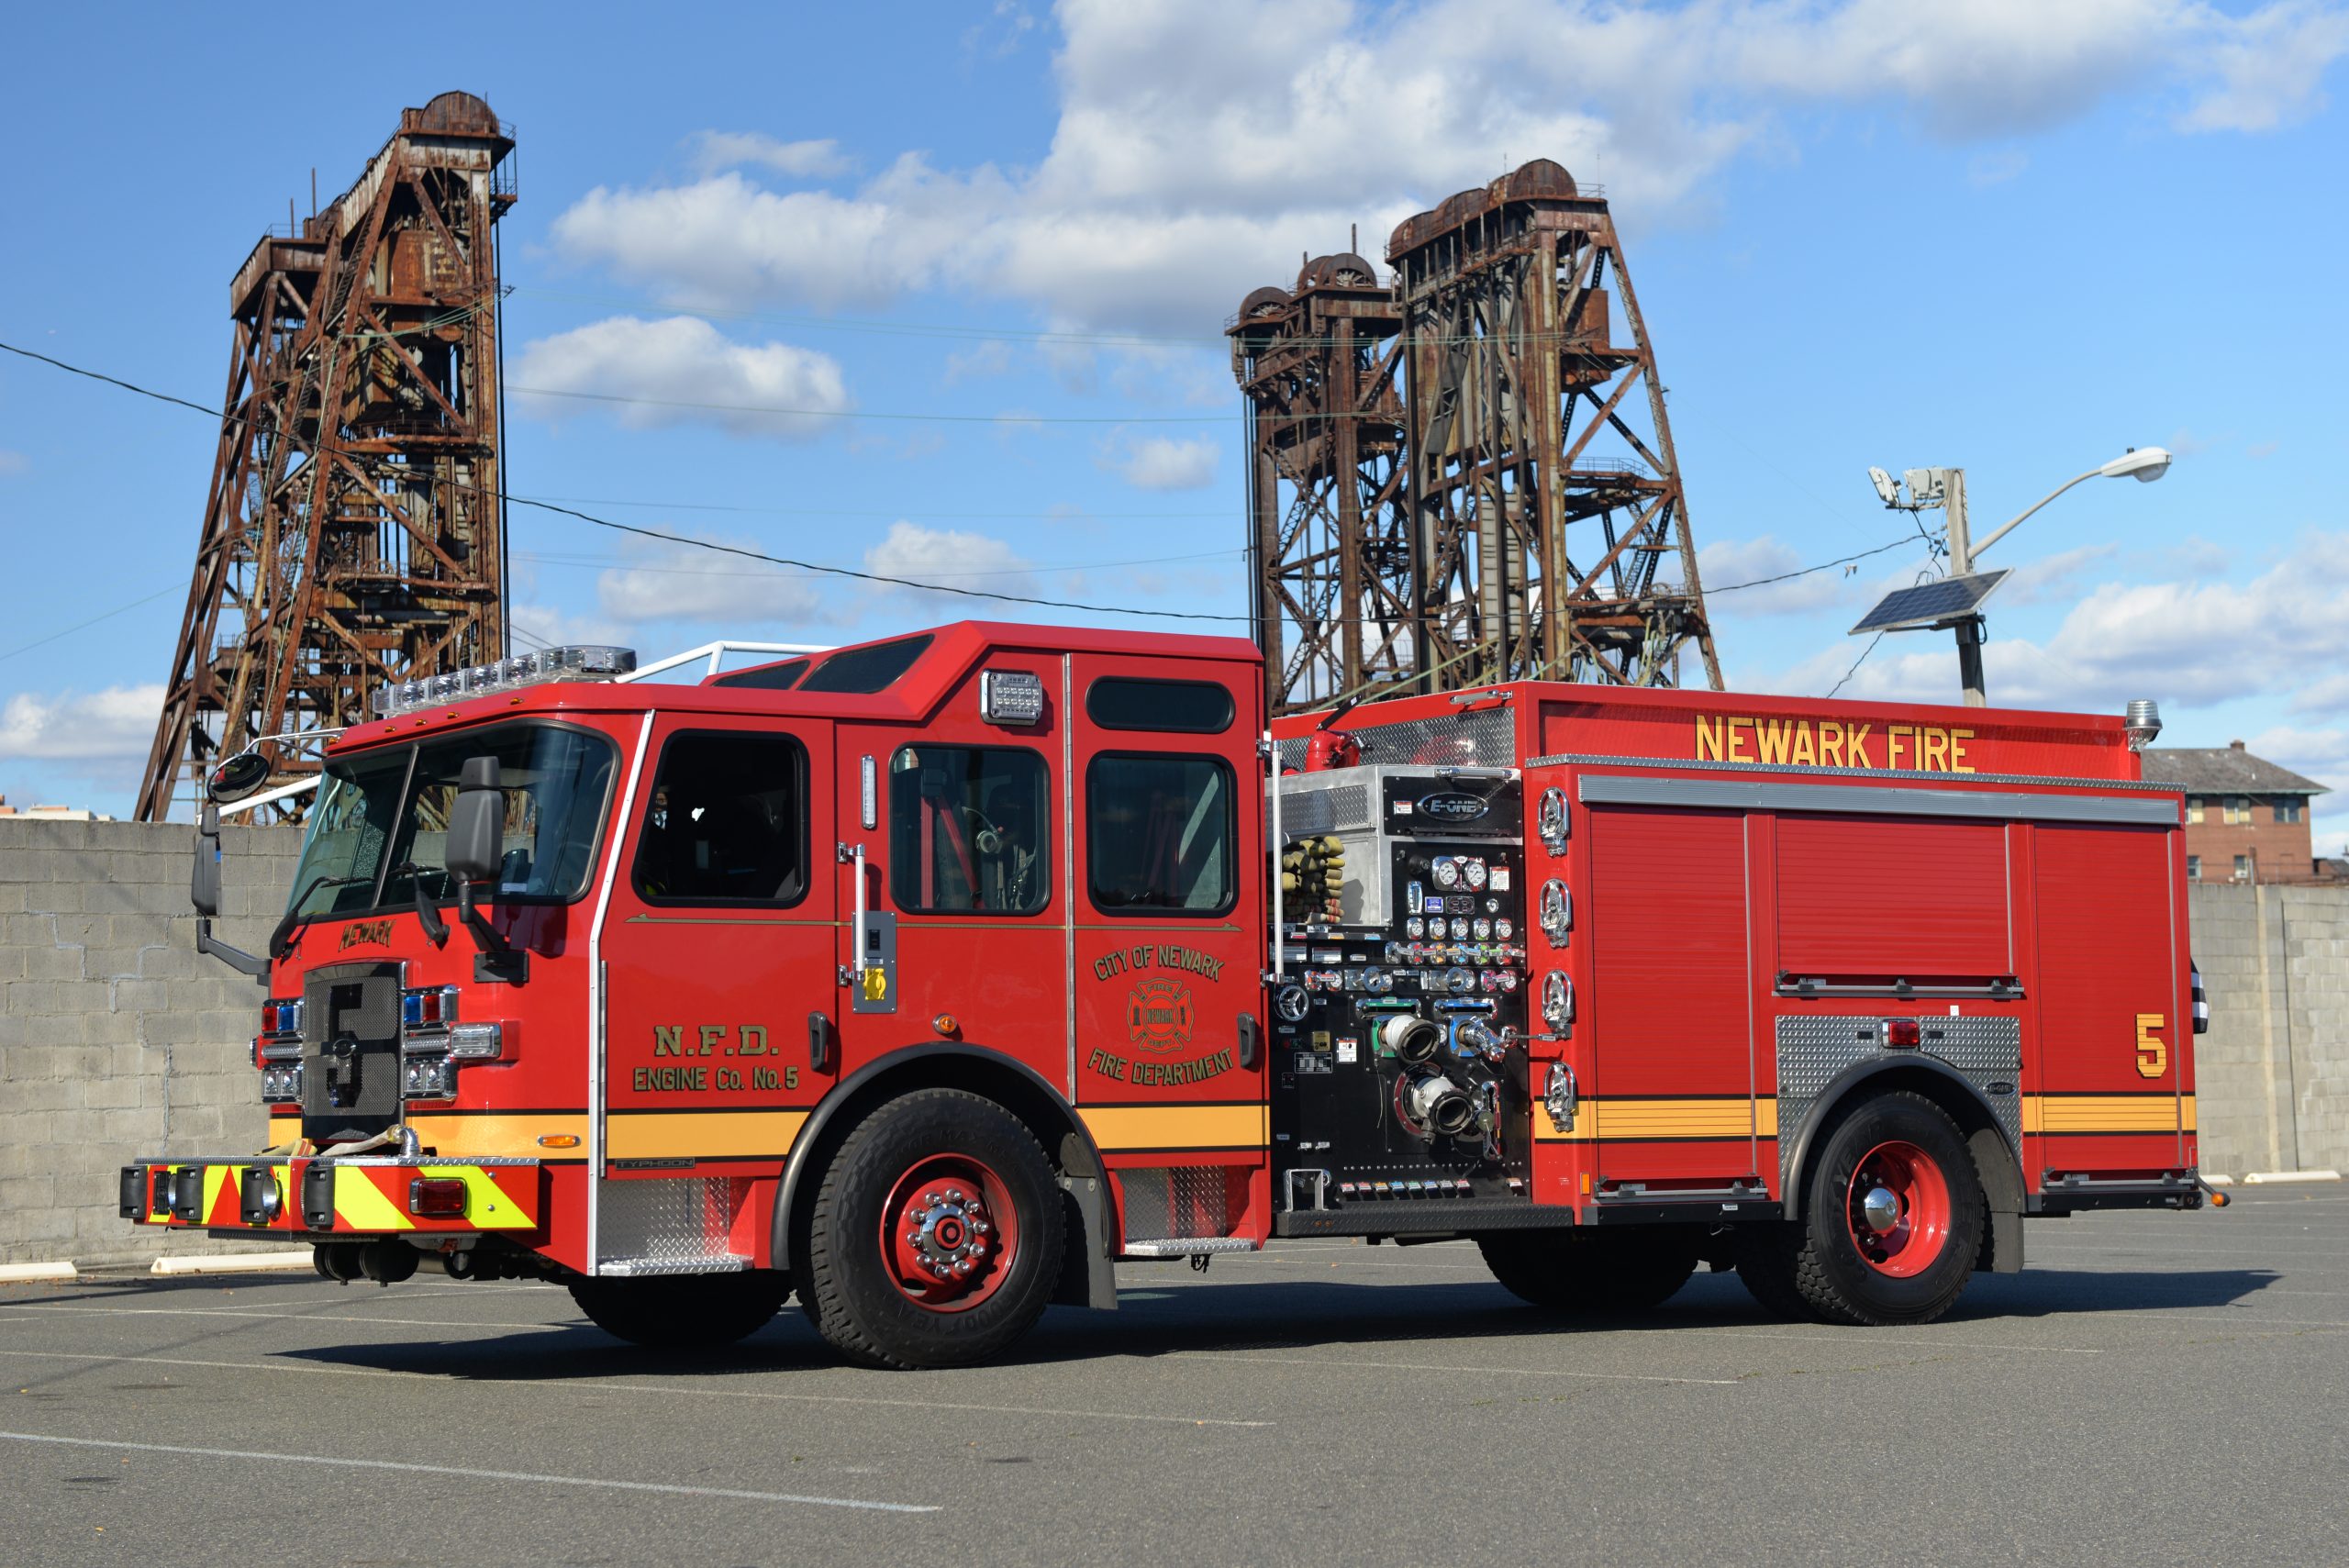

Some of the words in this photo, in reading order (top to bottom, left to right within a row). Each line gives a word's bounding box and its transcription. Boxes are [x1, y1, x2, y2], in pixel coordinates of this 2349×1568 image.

[1696, 714, 1872, 769] NEWARK
[1887, 725, 1976, 773] FIRE
[1430, 800, 1478, 814] E-ONE
[339, 919, 396, 952] NEWARK
[1094, 949, 1129, 981] CITY
[1131, 945, 1154, 968] OF
[1158, 945, 1225, 982] NEWARK
[1146, 984, 1174, 994] FIRE
[1147, 1008, 1174, 1025] NEWARK
[653, 1024, 780, 1056] N.F.D.
[2135, 1013, 2167, 1078] 5
[634, 1066, 708, 1091] ENGINE
[716, 1066, 745, 1090] Co.
[1087, 1048, 1129, 1080] FIRE
[1131, 1048, 1234, 1086] DEPARTMENT
[617, 1159, 694, 1168] TYPHOON
